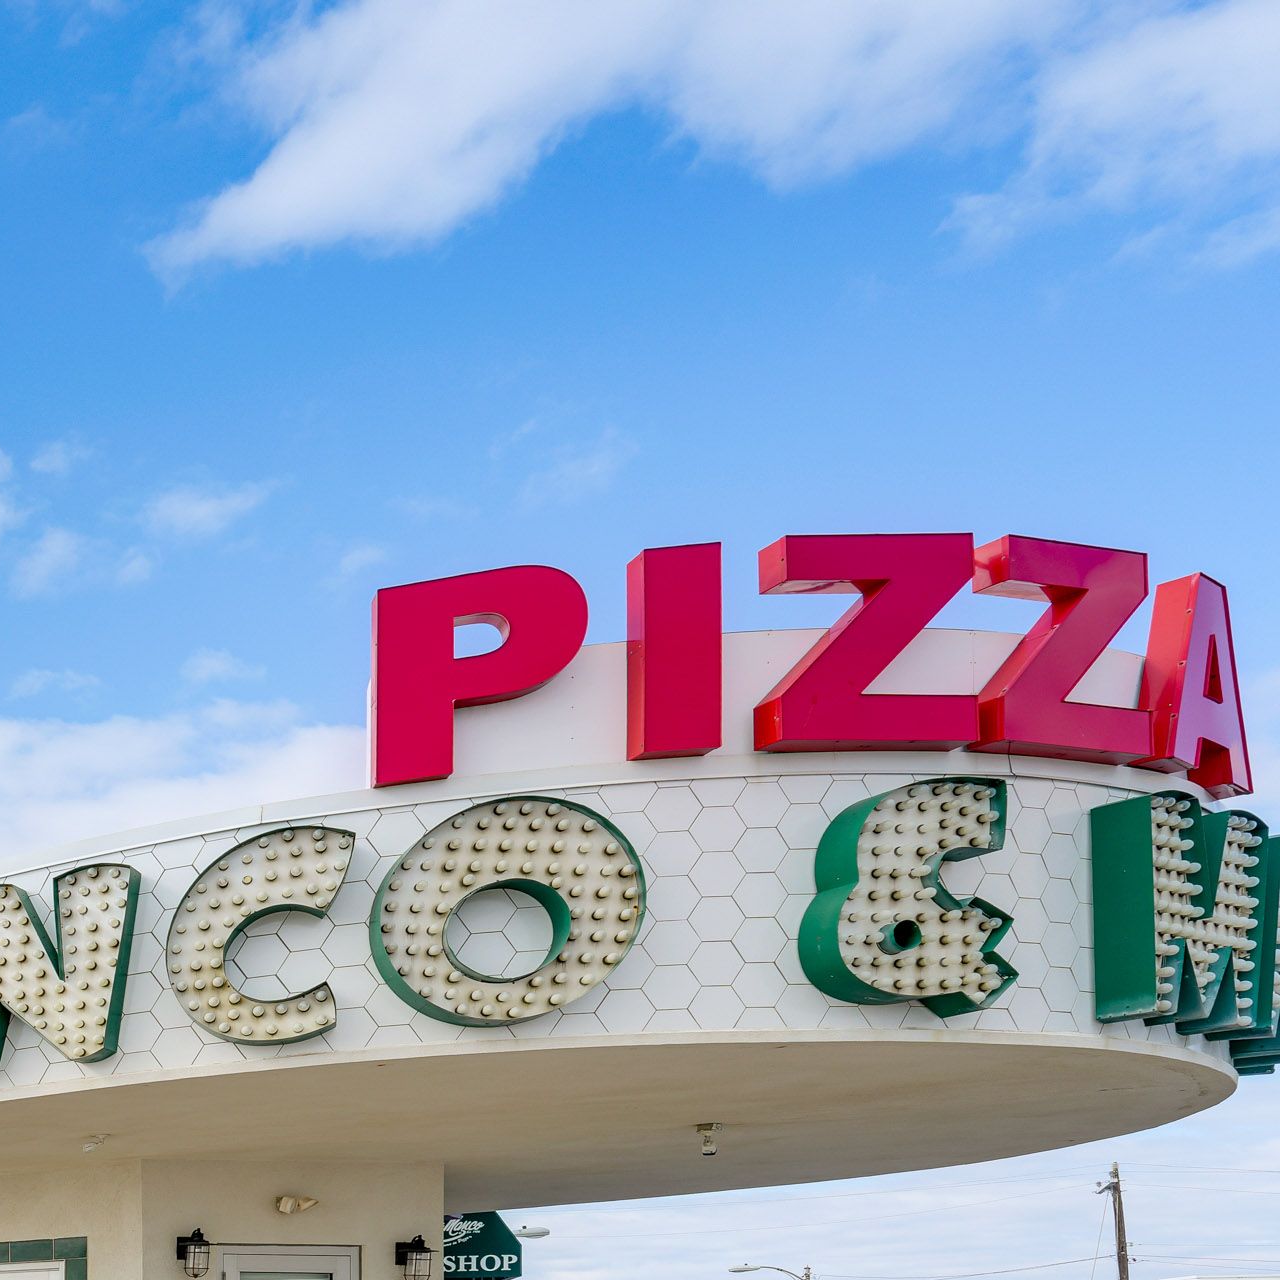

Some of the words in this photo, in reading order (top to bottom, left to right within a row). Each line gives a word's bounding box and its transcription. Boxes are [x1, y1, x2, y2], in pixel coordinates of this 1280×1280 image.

[372, 533, 1253, 796] PIZZA
[798, 776, 1019, 1018] &
[1091, 790, 1280, 1075] M
[443, 1215, 485, 1236] Manco
[443, 1254, 519, 1273] SHOP
